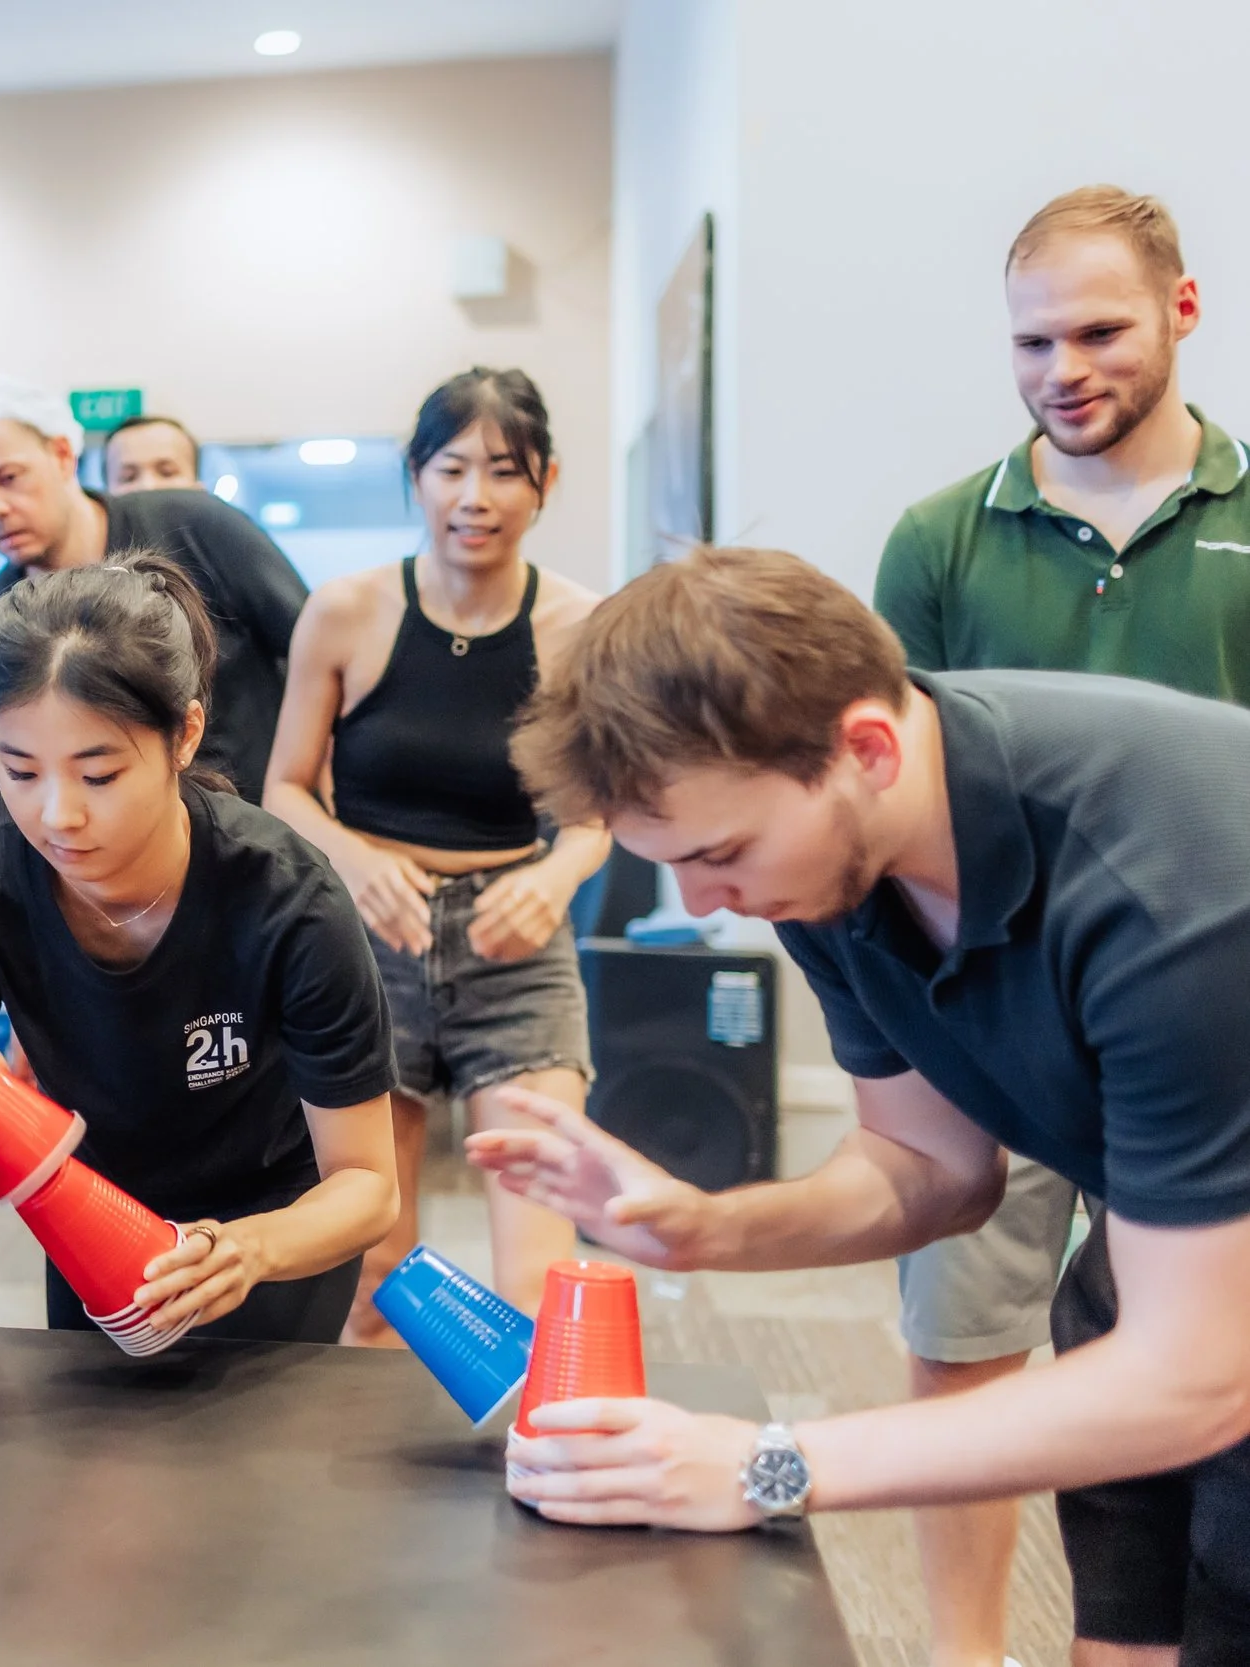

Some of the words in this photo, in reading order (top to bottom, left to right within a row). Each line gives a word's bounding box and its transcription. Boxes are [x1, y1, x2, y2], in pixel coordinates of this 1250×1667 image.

[184, 1012, 244, 1034] SINGAPORE
[186, 1026, 248, 1072] 24h
[188, 1070, 224, 1081] ENDURANCE
